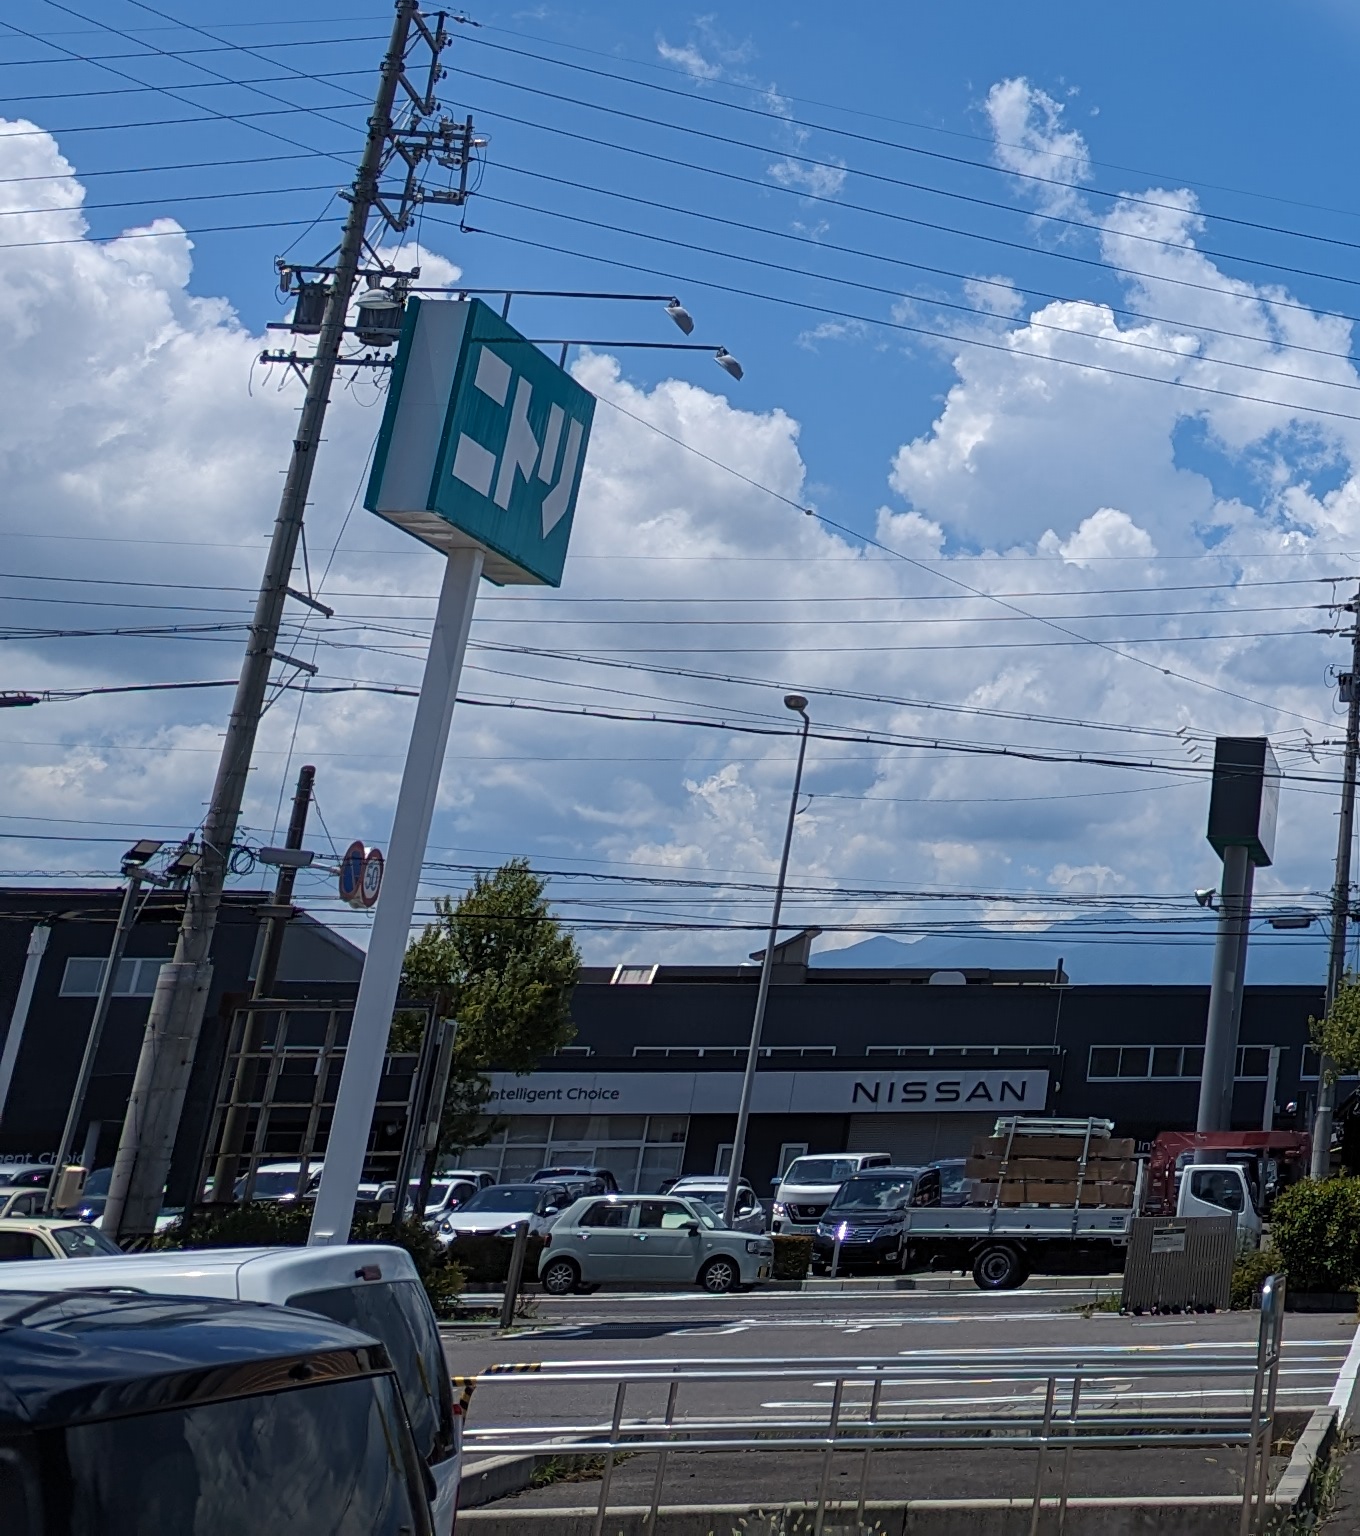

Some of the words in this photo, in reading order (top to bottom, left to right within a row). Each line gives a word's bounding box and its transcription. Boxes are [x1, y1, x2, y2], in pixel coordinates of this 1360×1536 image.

[452, 345, 584, 540] ニトリ
[365, 864, 379, 892] 50
[566, 1087, 620, 1100] Choice
[852, 1080, 1027, 1103] NISSAN
